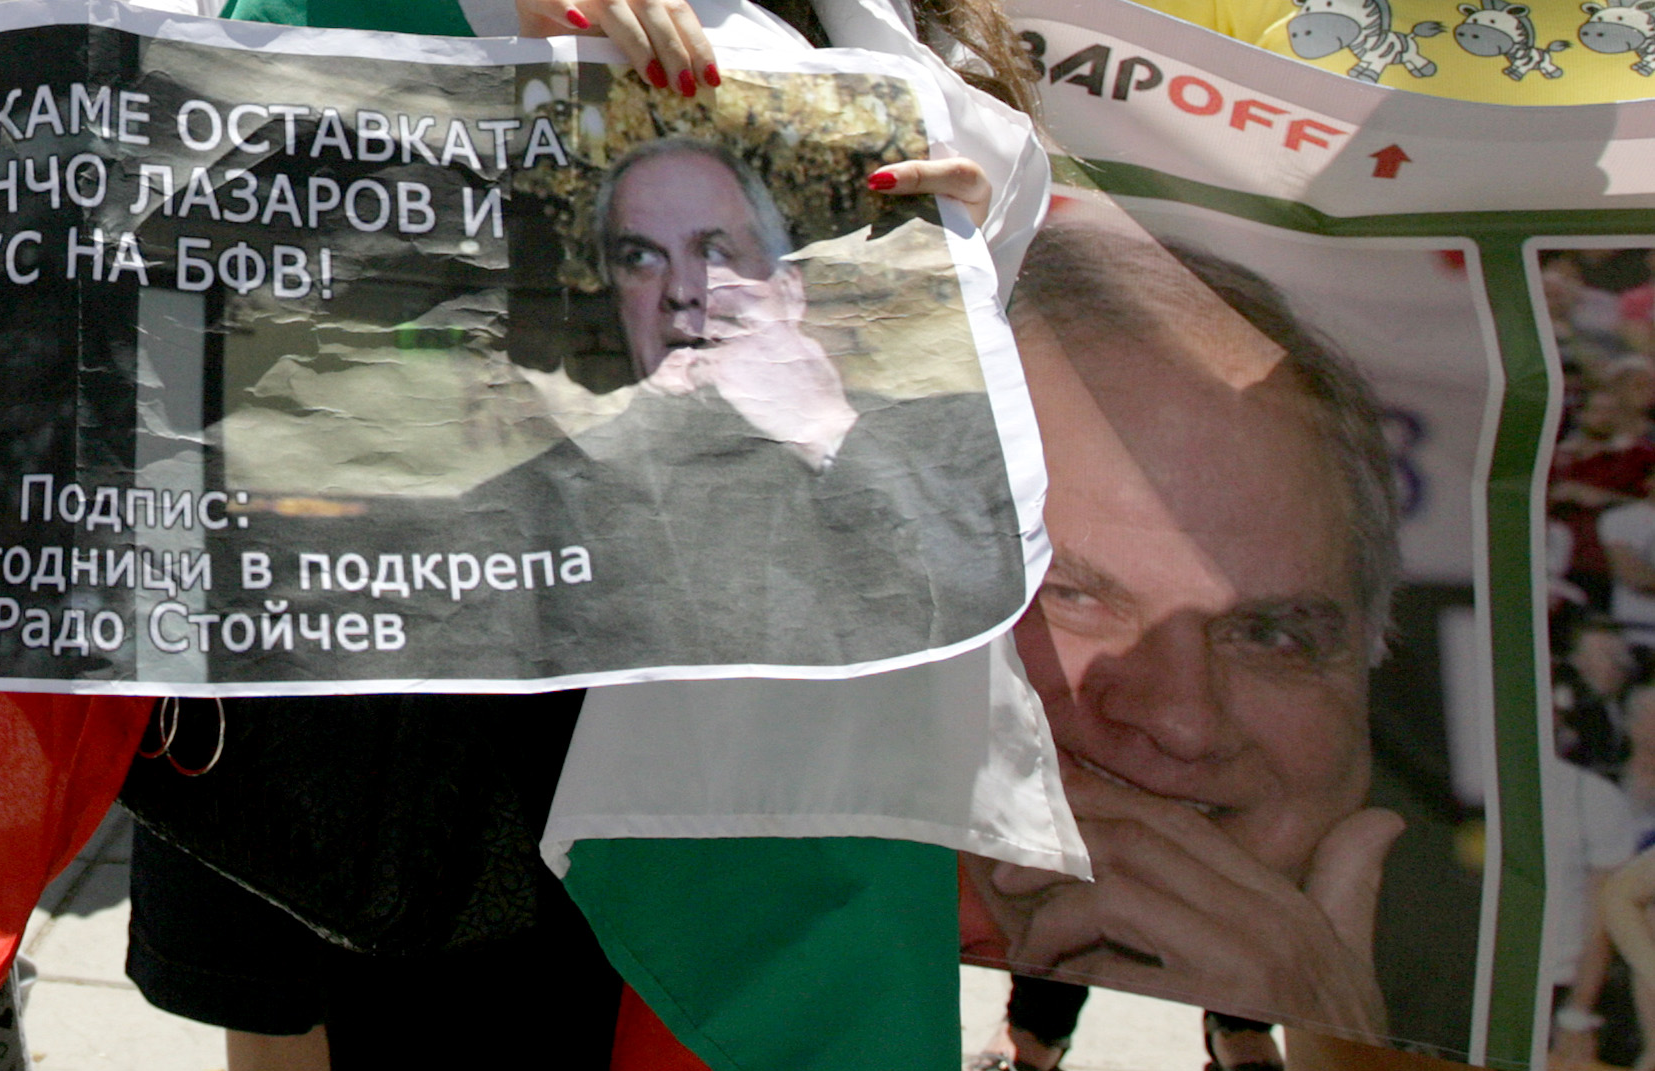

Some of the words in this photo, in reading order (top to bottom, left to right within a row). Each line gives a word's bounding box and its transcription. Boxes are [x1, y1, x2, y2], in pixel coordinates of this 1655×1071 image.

[176, 99, 569, 169] ОСТАВКАТА
[128, 164, 437, 235] ЛАЗАРОВ
[462, 187, 504, 239] И
[66, 228, 150, 286] НА
[175, 236, 334, 300] БФВ!
[19, 473, 252, 531] Подпис:
[242, 552, 274, 590] в
[299, 541, 594, 598] подкрепа
[149, 600, 408, 654] Стойчев
